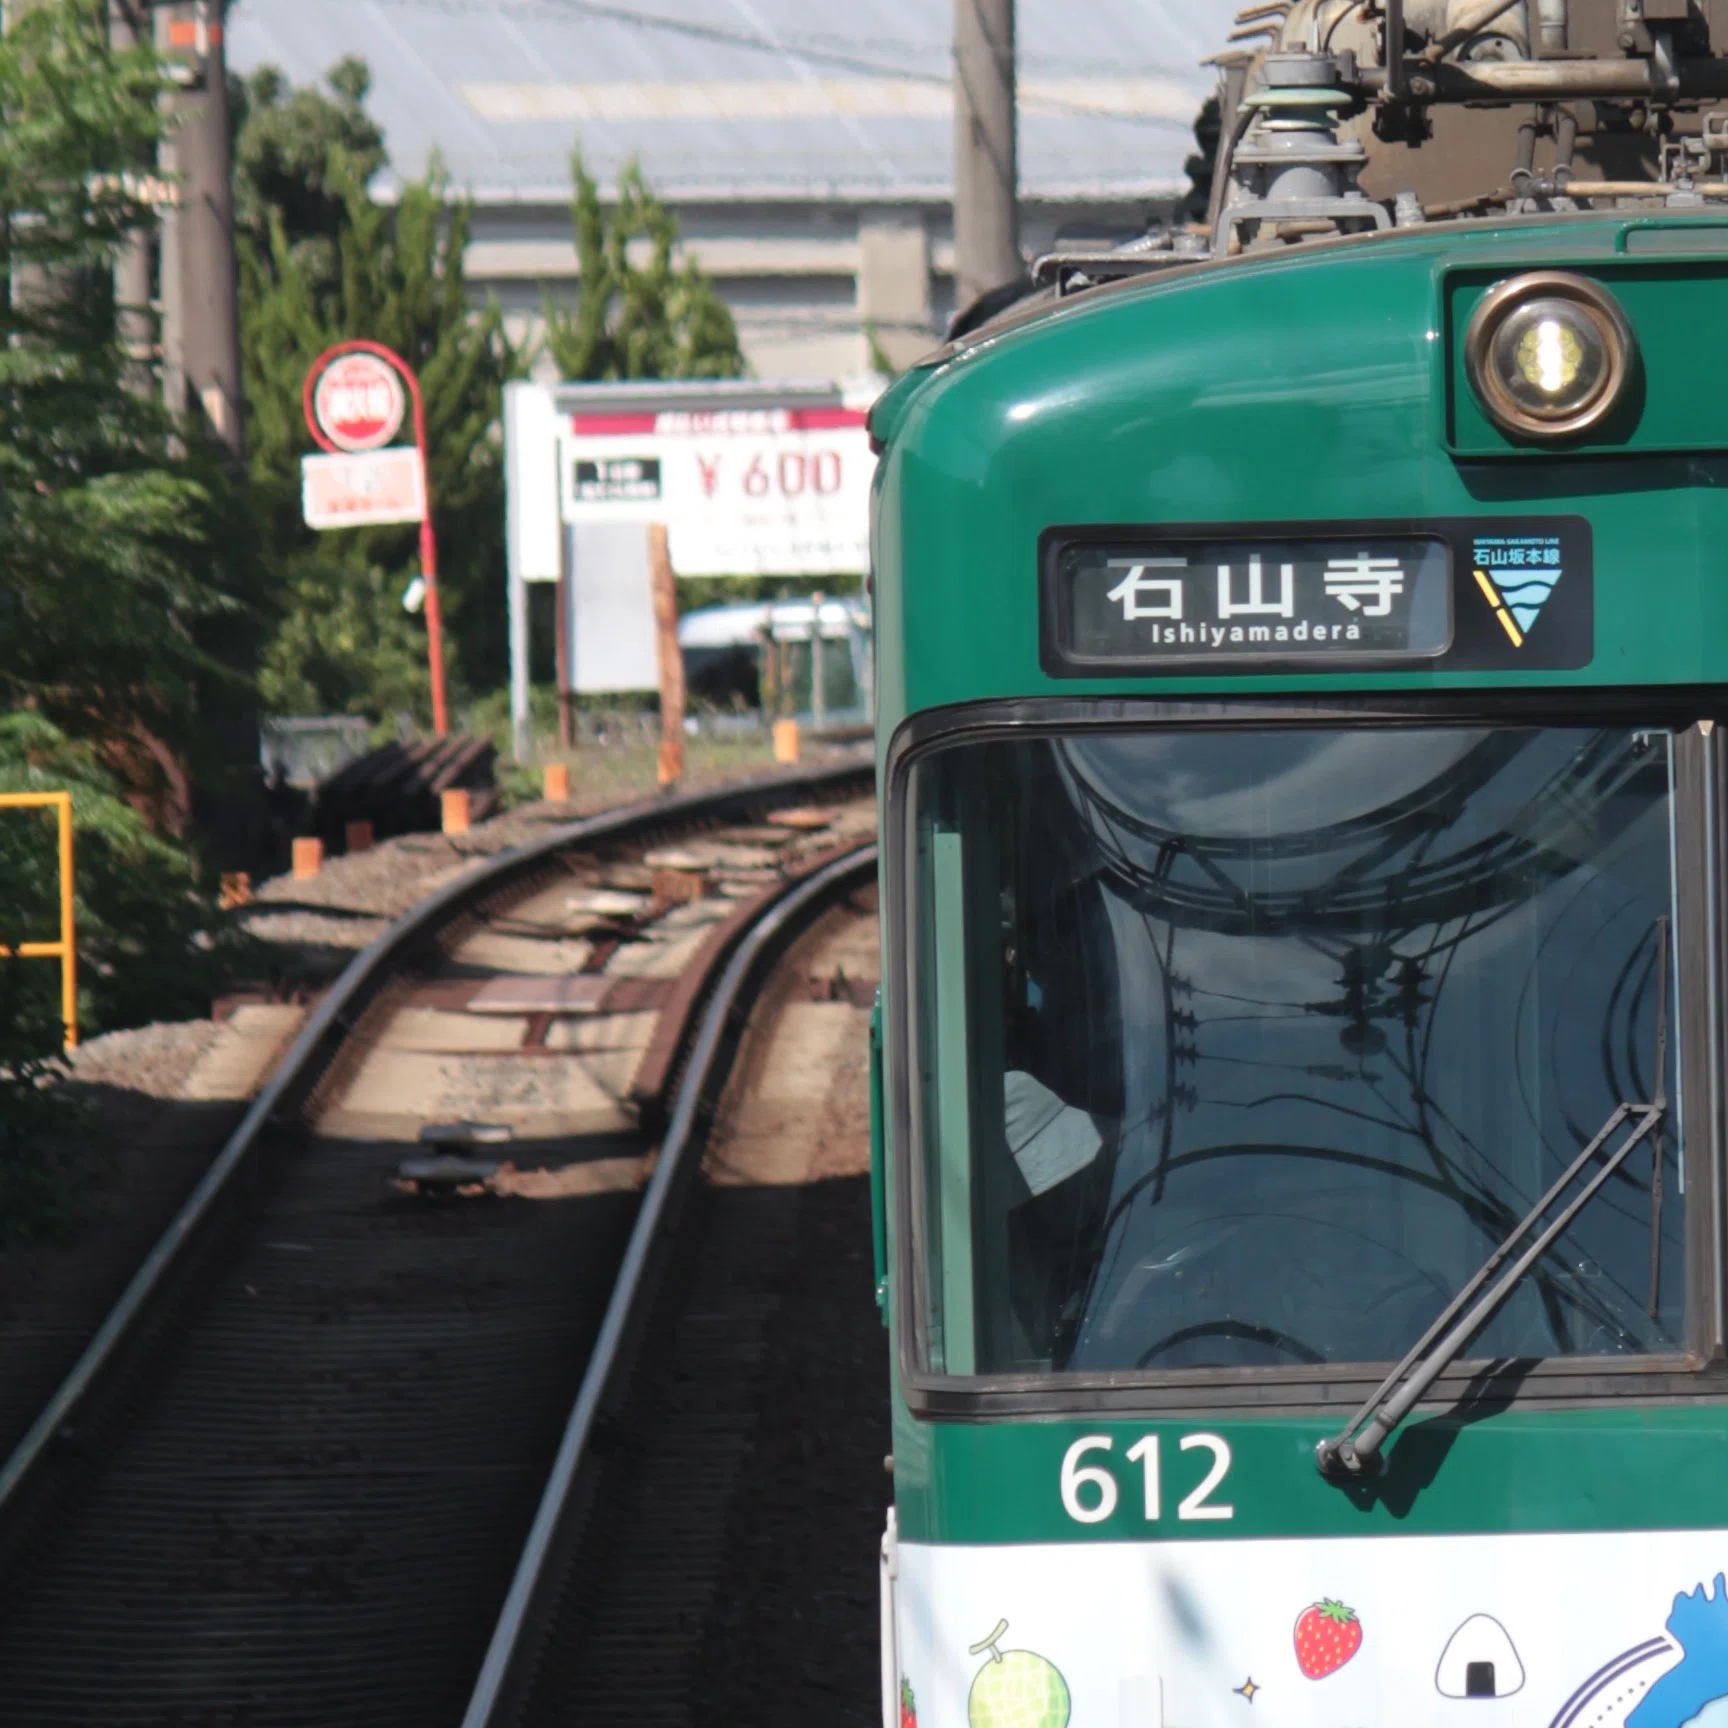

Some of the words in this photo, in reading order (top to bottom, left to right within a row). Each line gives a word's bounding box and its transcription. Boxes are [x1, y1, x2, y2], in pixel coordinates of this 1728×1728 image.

[1473, 548, 1561, 566] 石山坂本線
[1106, 553, 1405, 620] 石山寺
[1152, 620, 1361, 648] Ishiyamadera
[1060, 1433, 1234, 1523] 612
